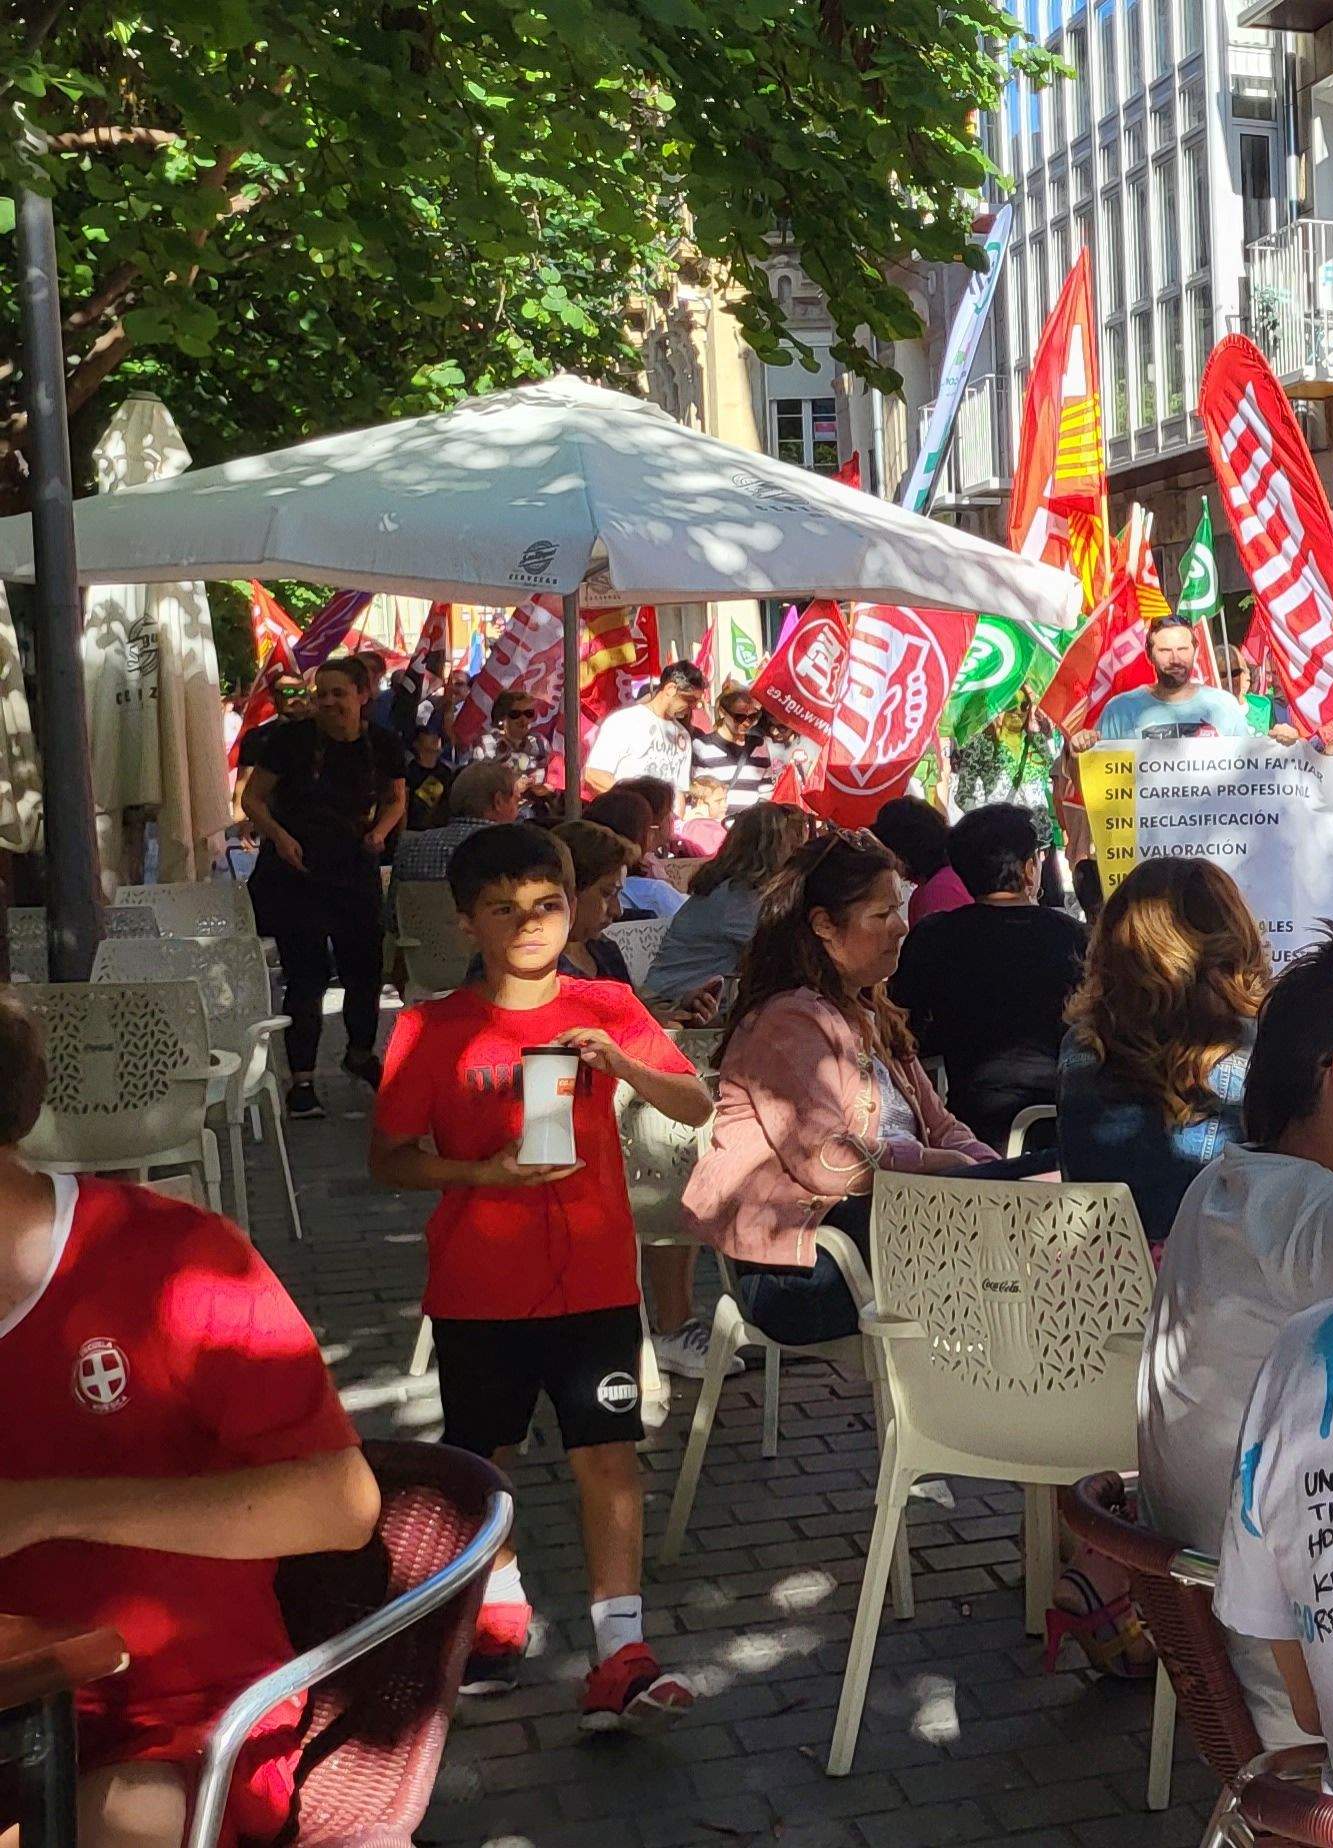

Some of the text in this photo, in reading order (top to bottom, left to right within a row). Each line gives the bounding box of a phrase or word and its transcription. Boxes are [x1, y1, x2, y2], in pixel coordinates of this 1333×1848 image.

[1104, 761, 1133, 775] SIN
[1138, 755, 1260, 774] CONCILIACIÓN
[1104, 787, 1133, 801] SIN
[1139, 785, 1212, 800] CARRERA
[1105, 809, 1280, 830] SIN RECLASIFICACIÓN
[1106, 838, 1248, 861] SIN VALORACIÓN
